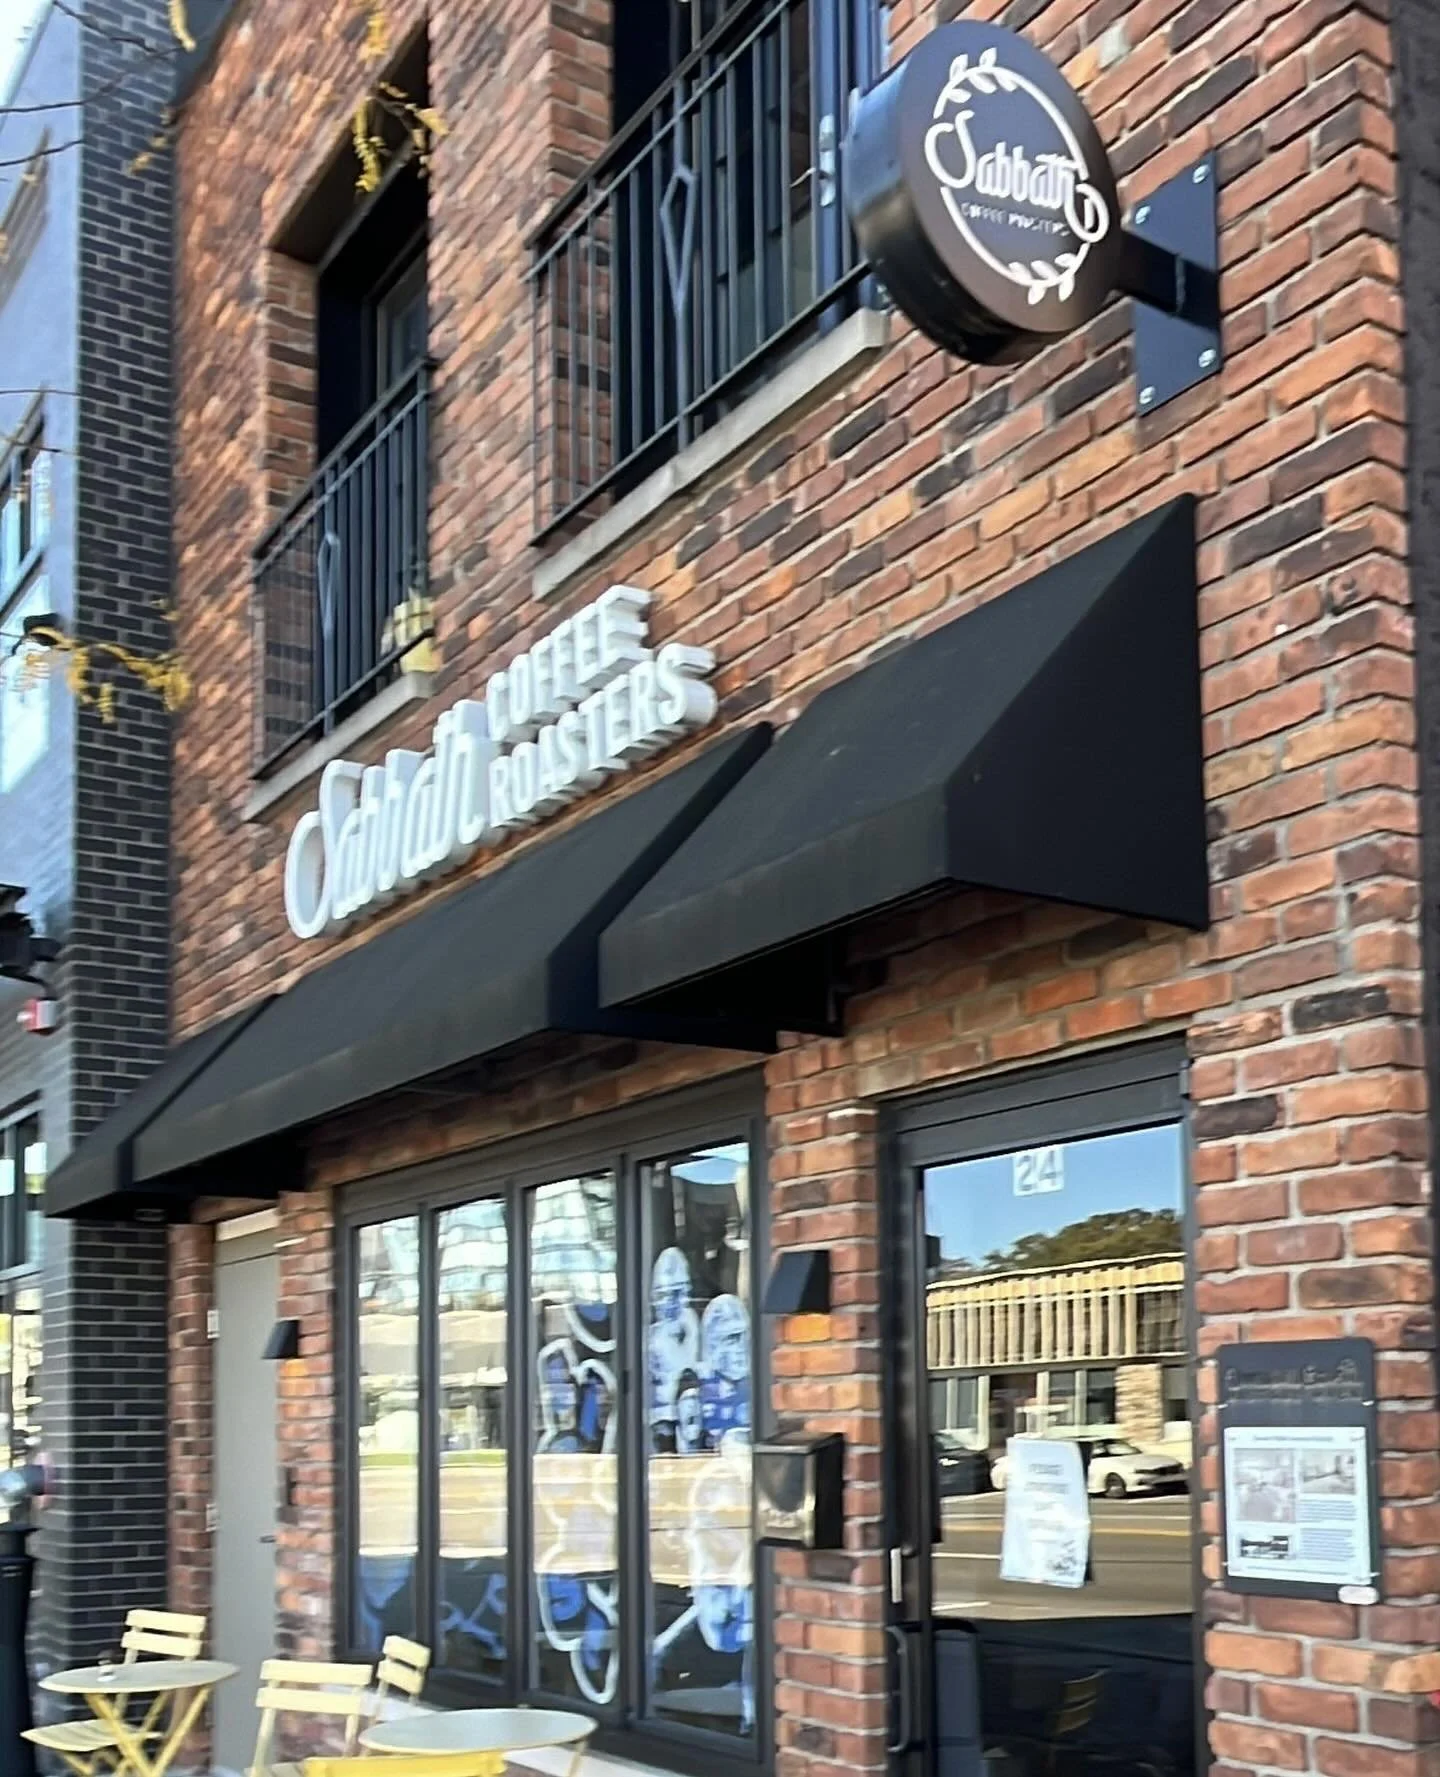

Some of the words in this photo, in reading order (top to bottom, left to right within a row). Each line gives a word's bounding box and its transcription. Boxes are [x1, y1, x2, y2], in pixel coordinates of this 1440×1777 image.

[924, 110, 1109, 242] Sabbath
[486, 584, 655, 742] COFFEE
[489, 643, 719, 828] ROASTERS
[285, 700, 491, 938] Sabbath
[1015, 1150, 1063, 1191] 24
